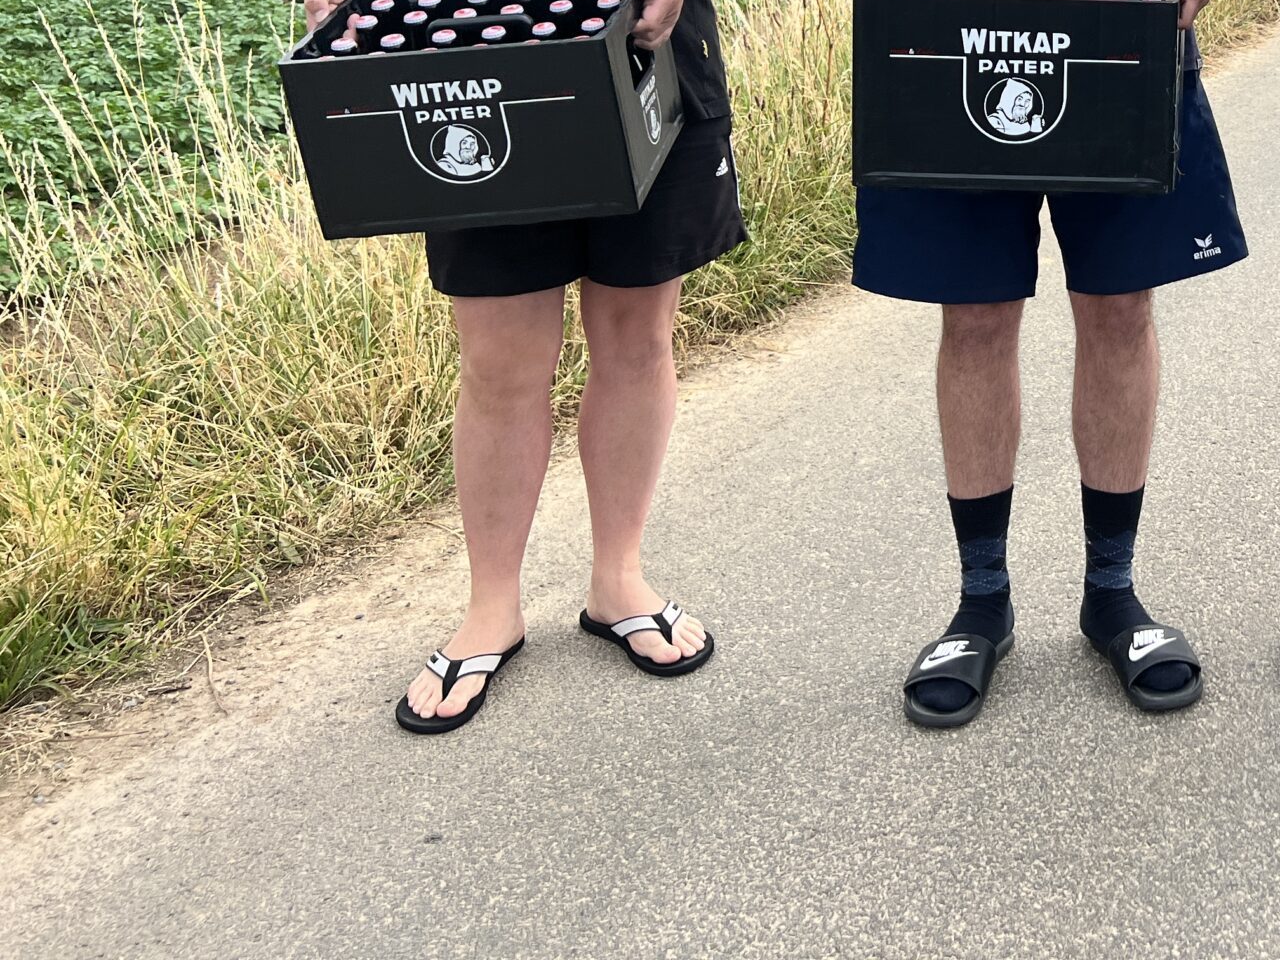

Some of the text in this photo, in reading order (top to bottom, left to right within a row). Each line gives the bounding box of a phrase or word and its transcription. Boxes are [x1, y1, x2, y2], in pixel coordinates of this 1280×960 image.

[960, 28, 1071, 54] WITKAP
[978, 59, 1054, 74] PATER
[390, 78, 502, 108] WITKAP
[414, 105, 492, 124] PATER
[1193, 246, 1221, 260] erima
[1133, 628, 1165, 649] NIKE
[930, 640, 970, 659] NIKE
